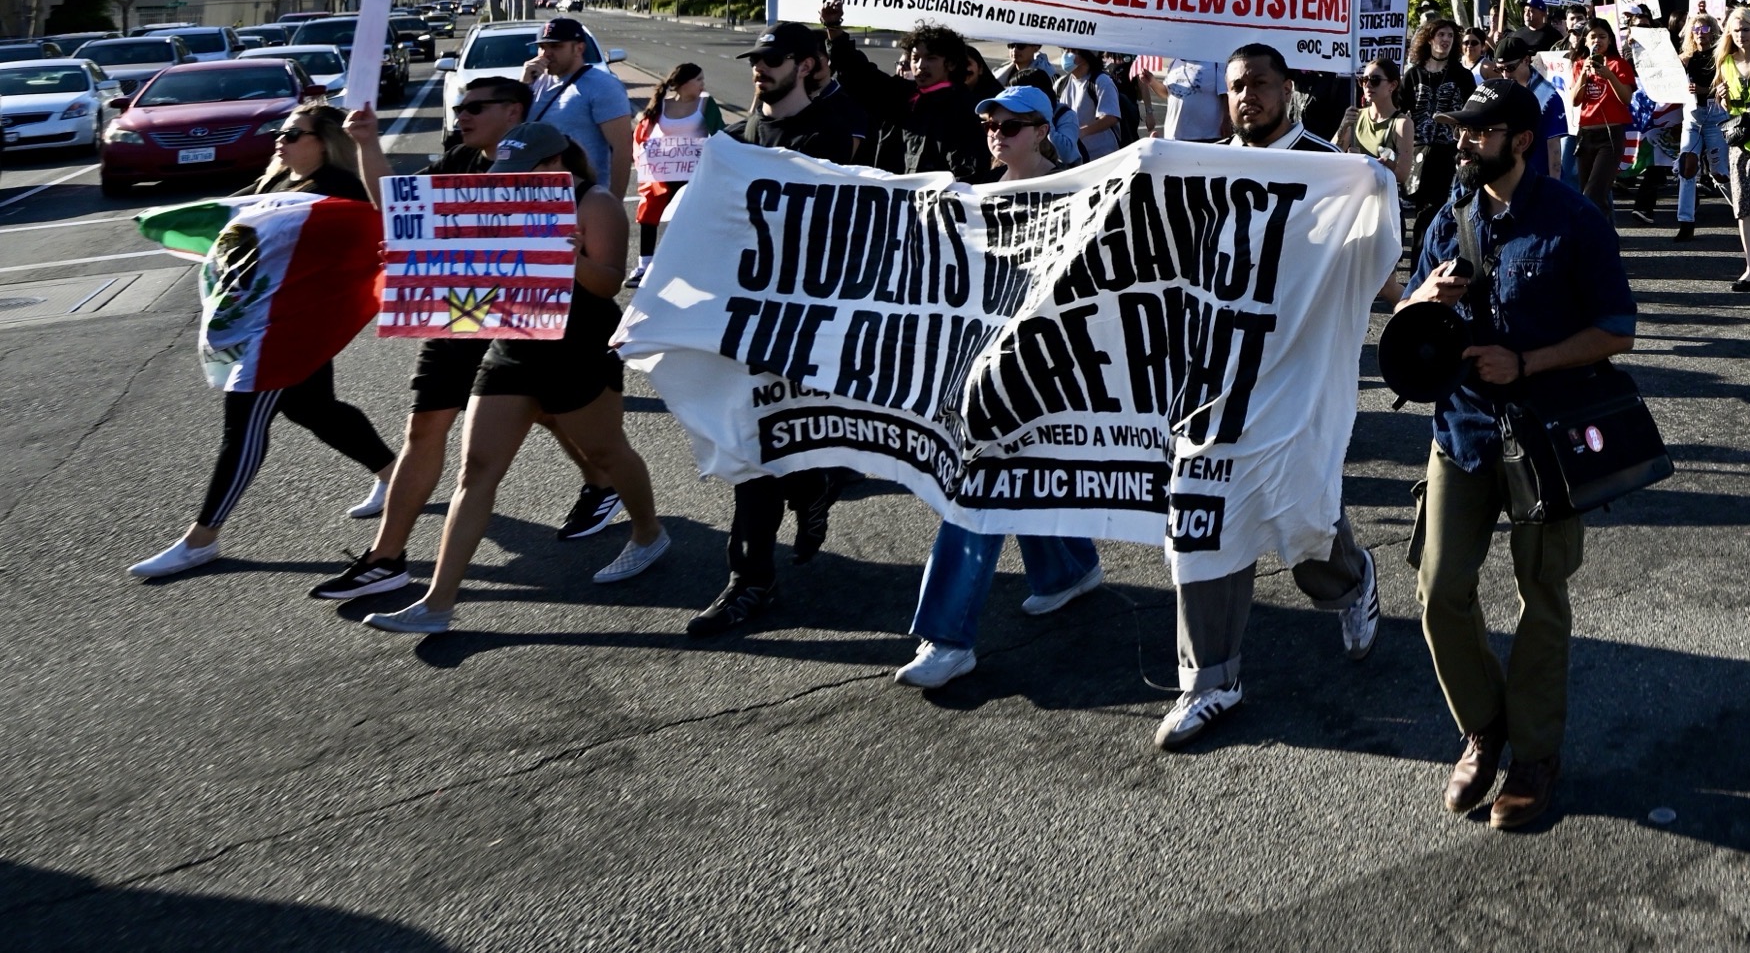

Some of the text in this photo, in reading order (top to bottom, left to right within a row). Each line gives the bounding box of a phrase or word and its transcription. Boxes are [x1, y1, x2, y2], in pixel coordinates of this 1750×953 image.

[985, 5, 1015, 25] AND
[1018, 12, 1097, 36] LIBERATION
[1359, 13, 1404, 30] STICE FOR
[1296, 39, 1351, 60] @OC_PSL
[1359, 36, 1404, 47] ENEE
[391, 176, 420, 202] ICE
[393, 214, 425, 240] OUT
[440, 212, 561, 240] IS NOT OUR
[737, 178, 971, 308] STUDENTS
[404, 249, 527, 277] AMERICA
[393, 286, 436, 328] NO
[1118, 286, 1278, 445] RIHT
[752, 381, 785, 408] NO
[771, 415, 937, 469] STUDENTS FOR
[997, 424, 1163, 455] WE NEED A WHOL
[990, 469, 1028, 498] AT
[1033, 469, 1068, 498] UC
[1075, 469, 1153, 502] IRVINE
